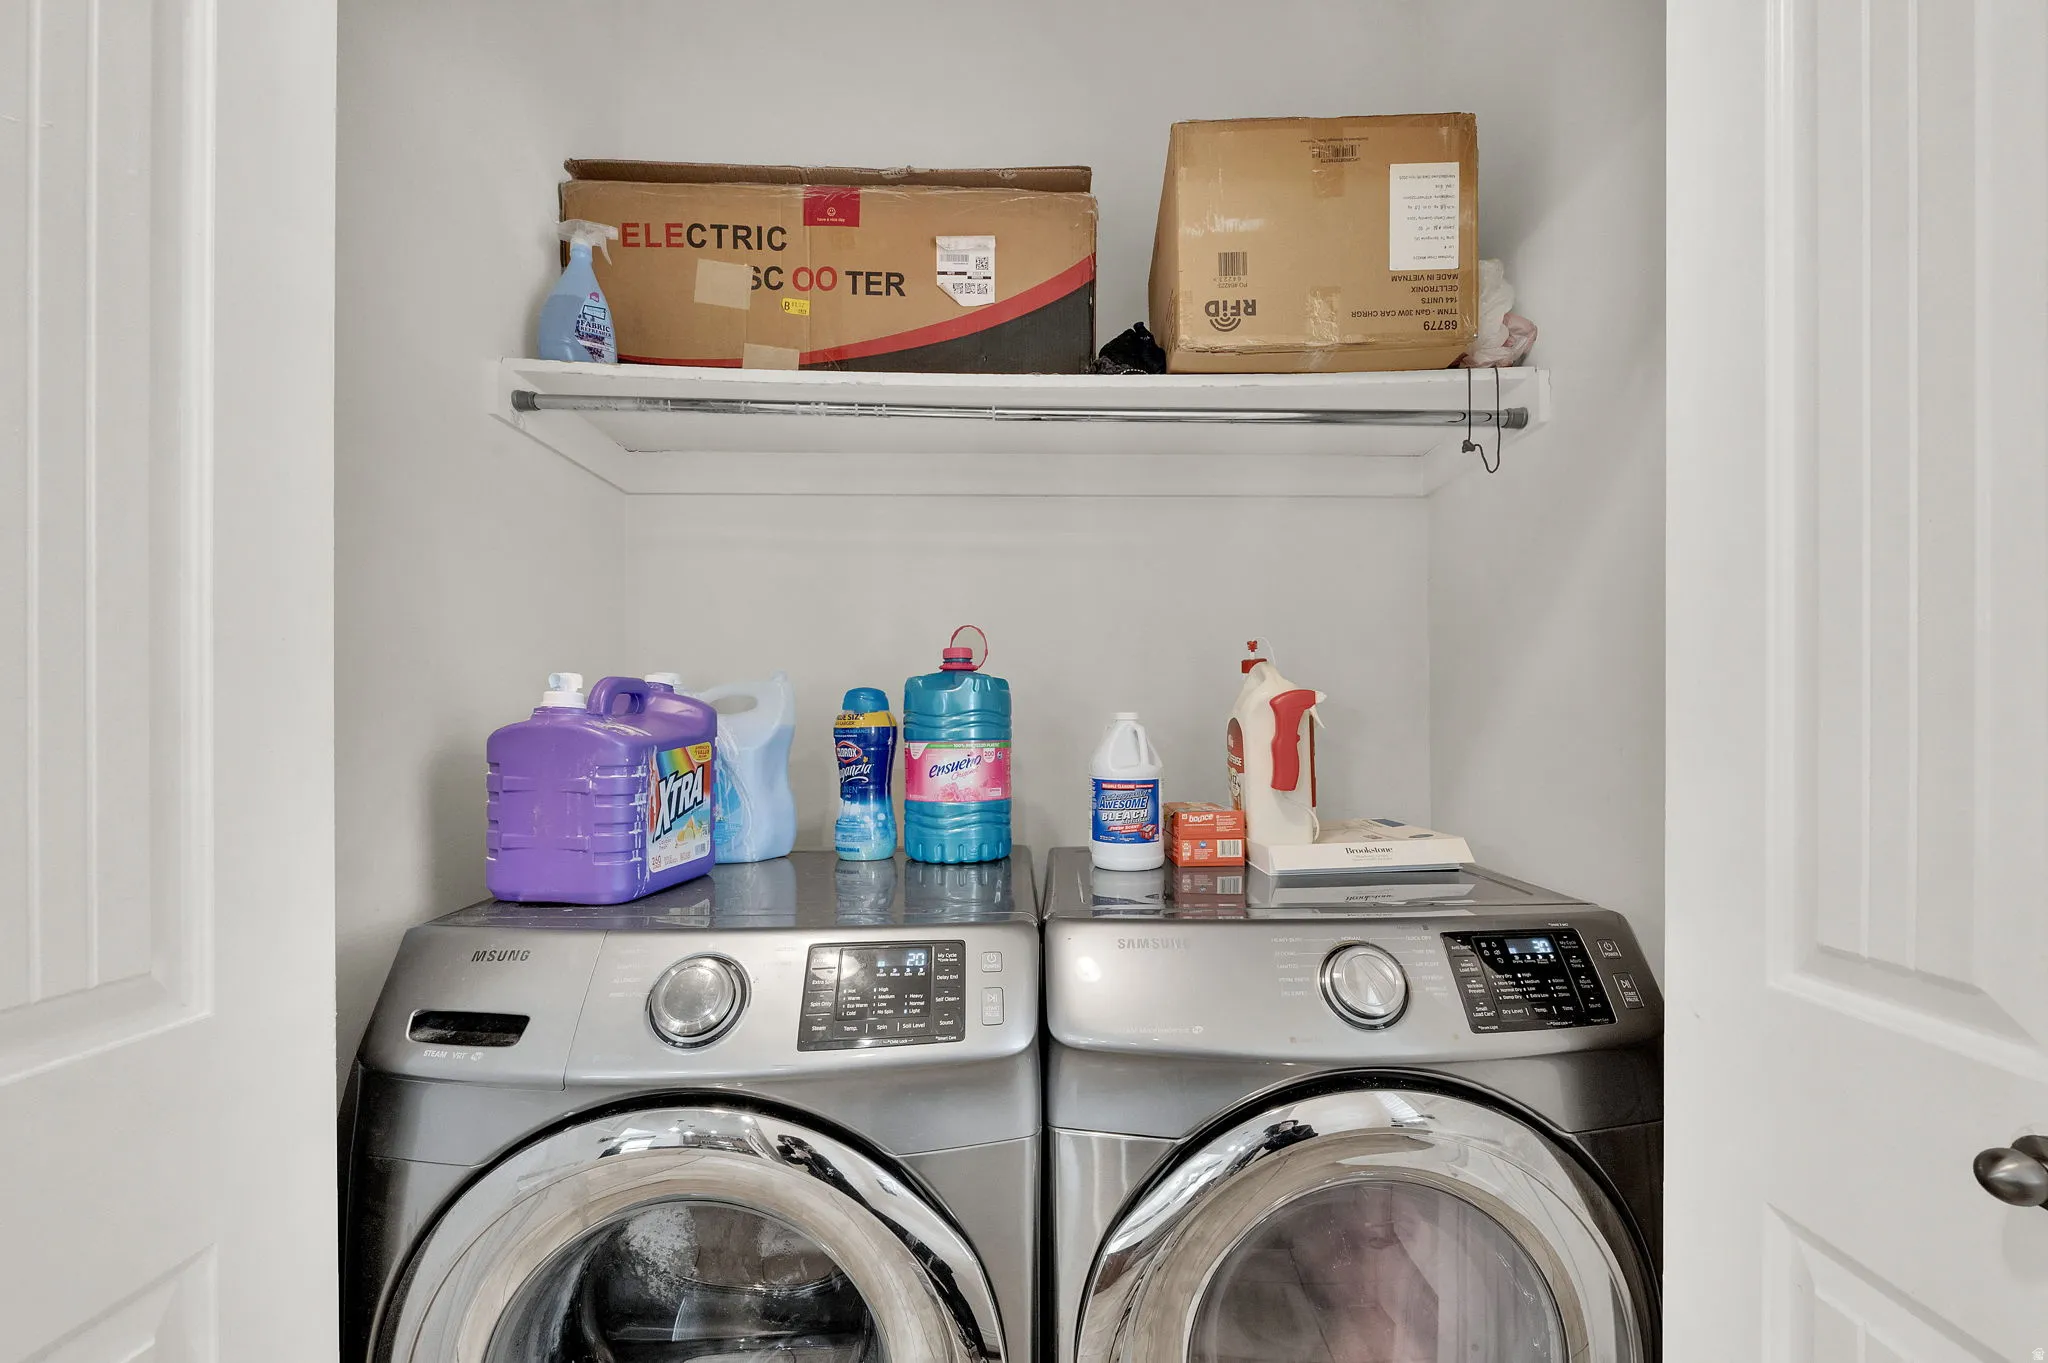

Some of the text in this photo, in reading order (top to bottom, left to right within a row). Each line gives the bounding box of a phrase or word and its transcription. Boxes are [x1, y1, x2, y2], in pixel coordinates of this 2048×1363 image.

[621, 222, 788, 251] ELECTRIC
[1391, 274, 1425, 282] VIETNAM
[1411, 284, 1458, 292] CELLTRONIX
[1351, 310, 1378, 318] CHRGR
[1415, 308, 1431, 316] GaN
[580, 320, 611, 332] FABRIC
[1423, 320, 1458, 331] 68779
[652, 764, 705, 843] XTRA
[1099, 795, 1149, 809] AWESOME
[1102, 810, 1148, 822] BLEACH
[1189, 814, 1214, 822] bounce
[1345, 846, 1393, 855] Brookstone
[1117, 938, 1191, 949] SAMSUNG
[906, 952, 925, 966] 20
